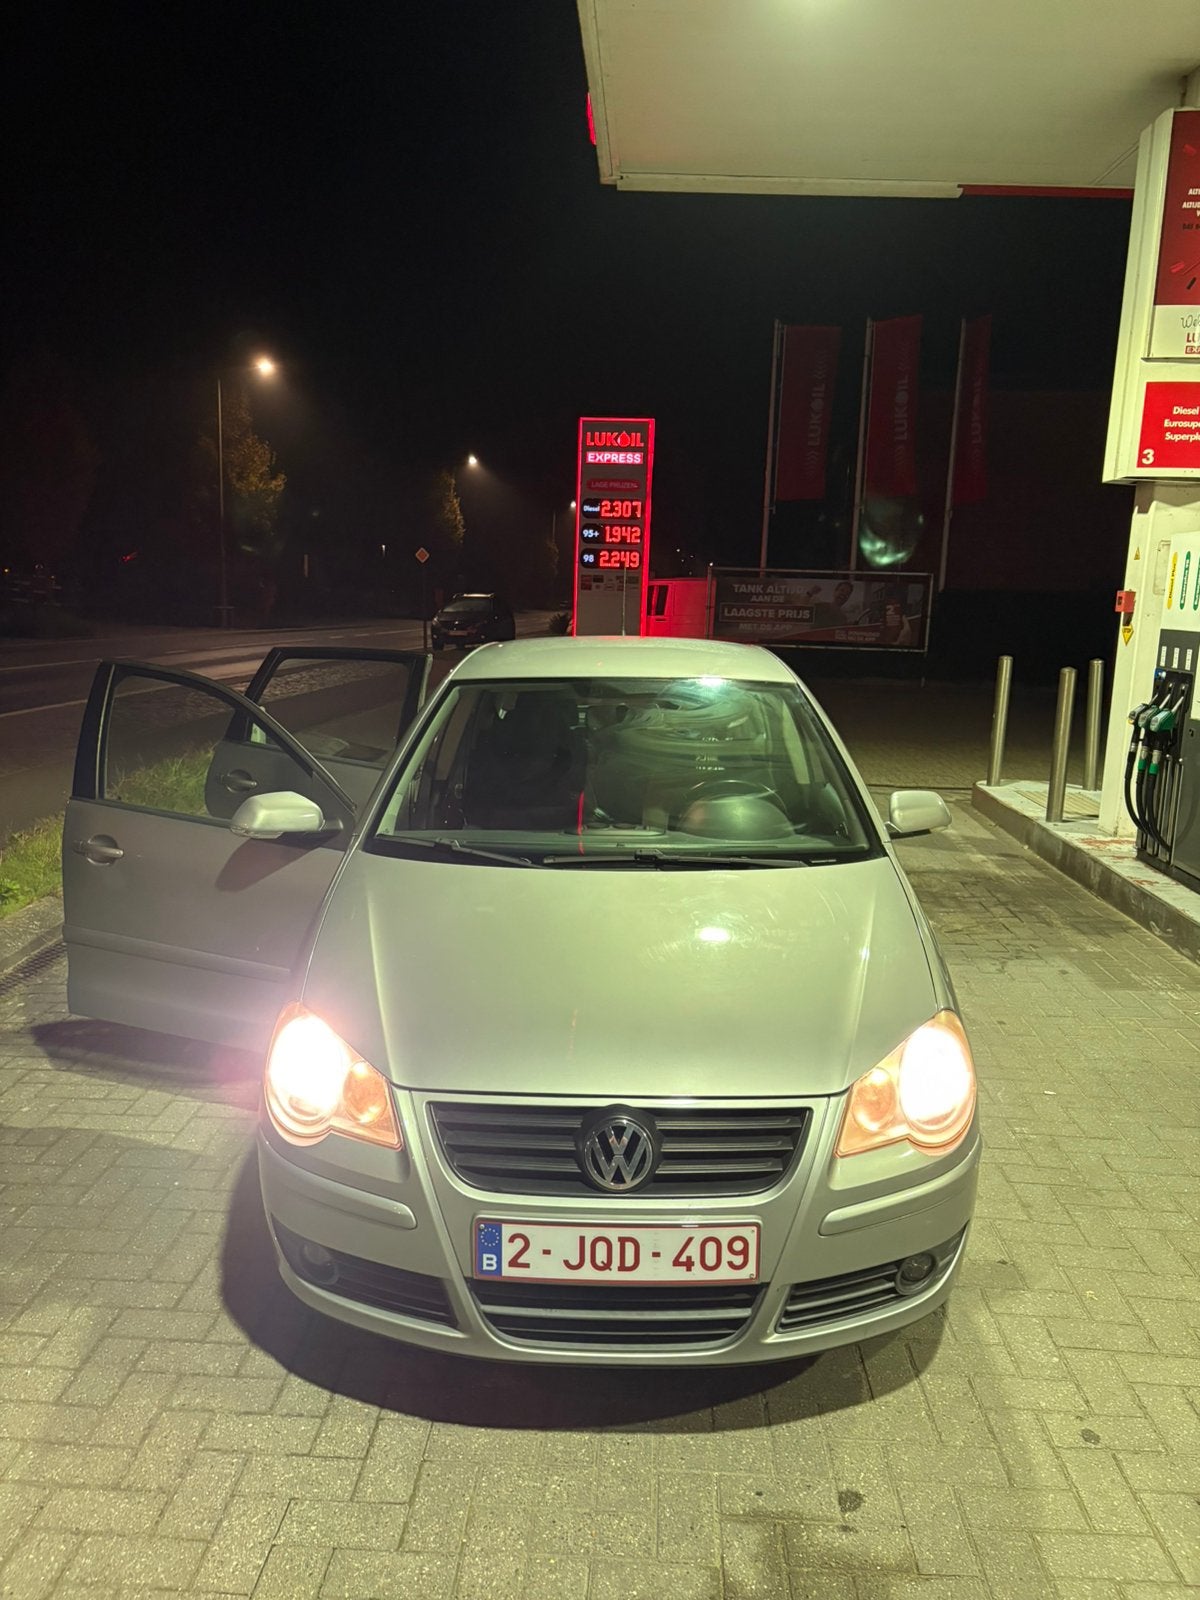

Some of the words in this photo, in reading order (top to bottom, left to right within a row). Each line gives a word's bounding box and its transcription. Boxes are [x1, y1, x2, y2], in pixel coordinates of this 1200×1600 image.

[807, 383, 826, 447] LUKOIL
[894, 375, 909, 441] LUKOIL
[1172, 406, 1200, 415] Diesel
[586, 431, 644, 447] LUKOIL
[587, 453, 641, 464] EXPRESS
[1141, 448, 1155, 465] 3
[601, 500, 642, 518] 2.307
[582, 529, 599, 538] 95+
[605, 526, 641, 543] 1.942
[583, 554, 595, 563] 98
[599, 550, 640, 568] 2.249
[732, 584, 763, 593] TANK
[772, 595, 785, 603] DE
[724, 607, 775, 618] LAAGSTE
[778, 609, 810, 619] PRIJS
[482, 1254, 497, 1271] B
